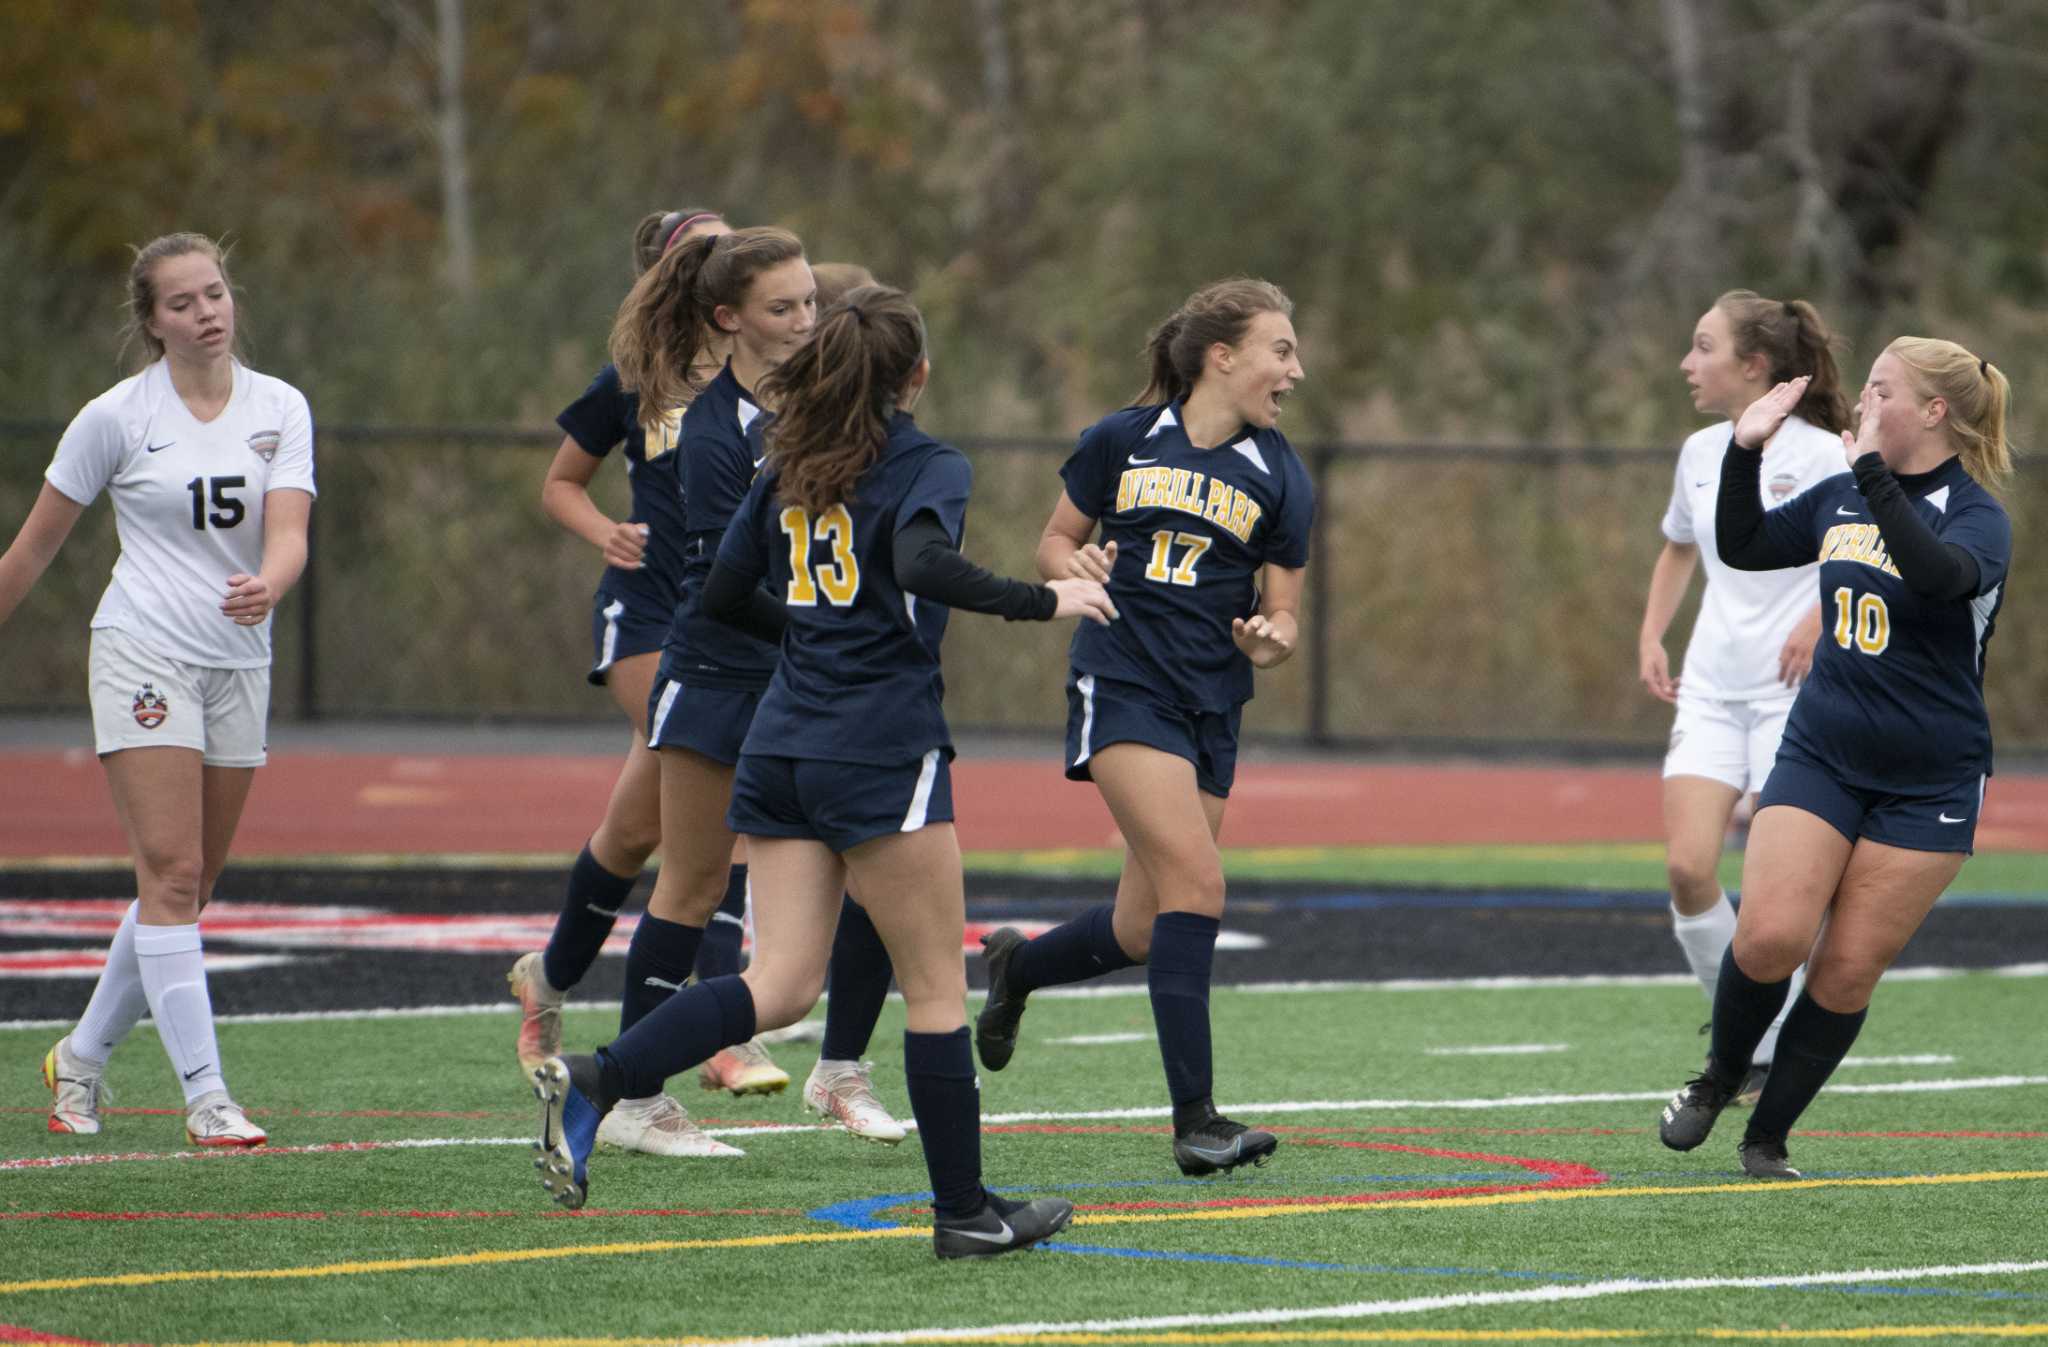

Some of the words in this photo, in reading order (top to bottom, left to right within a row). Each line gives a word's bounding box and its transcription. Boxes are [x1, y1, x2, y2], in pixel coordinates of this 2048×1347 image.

[187, 475, 246, 531] 15
[1116, 466, 1205, 516] AVERILL
[1204, 477, 1262, 544] PARK
[780, 503, 860, 607] 13
[1145, 529, 1212, 587] 17
[1833, 586, 1890, 656] 10
